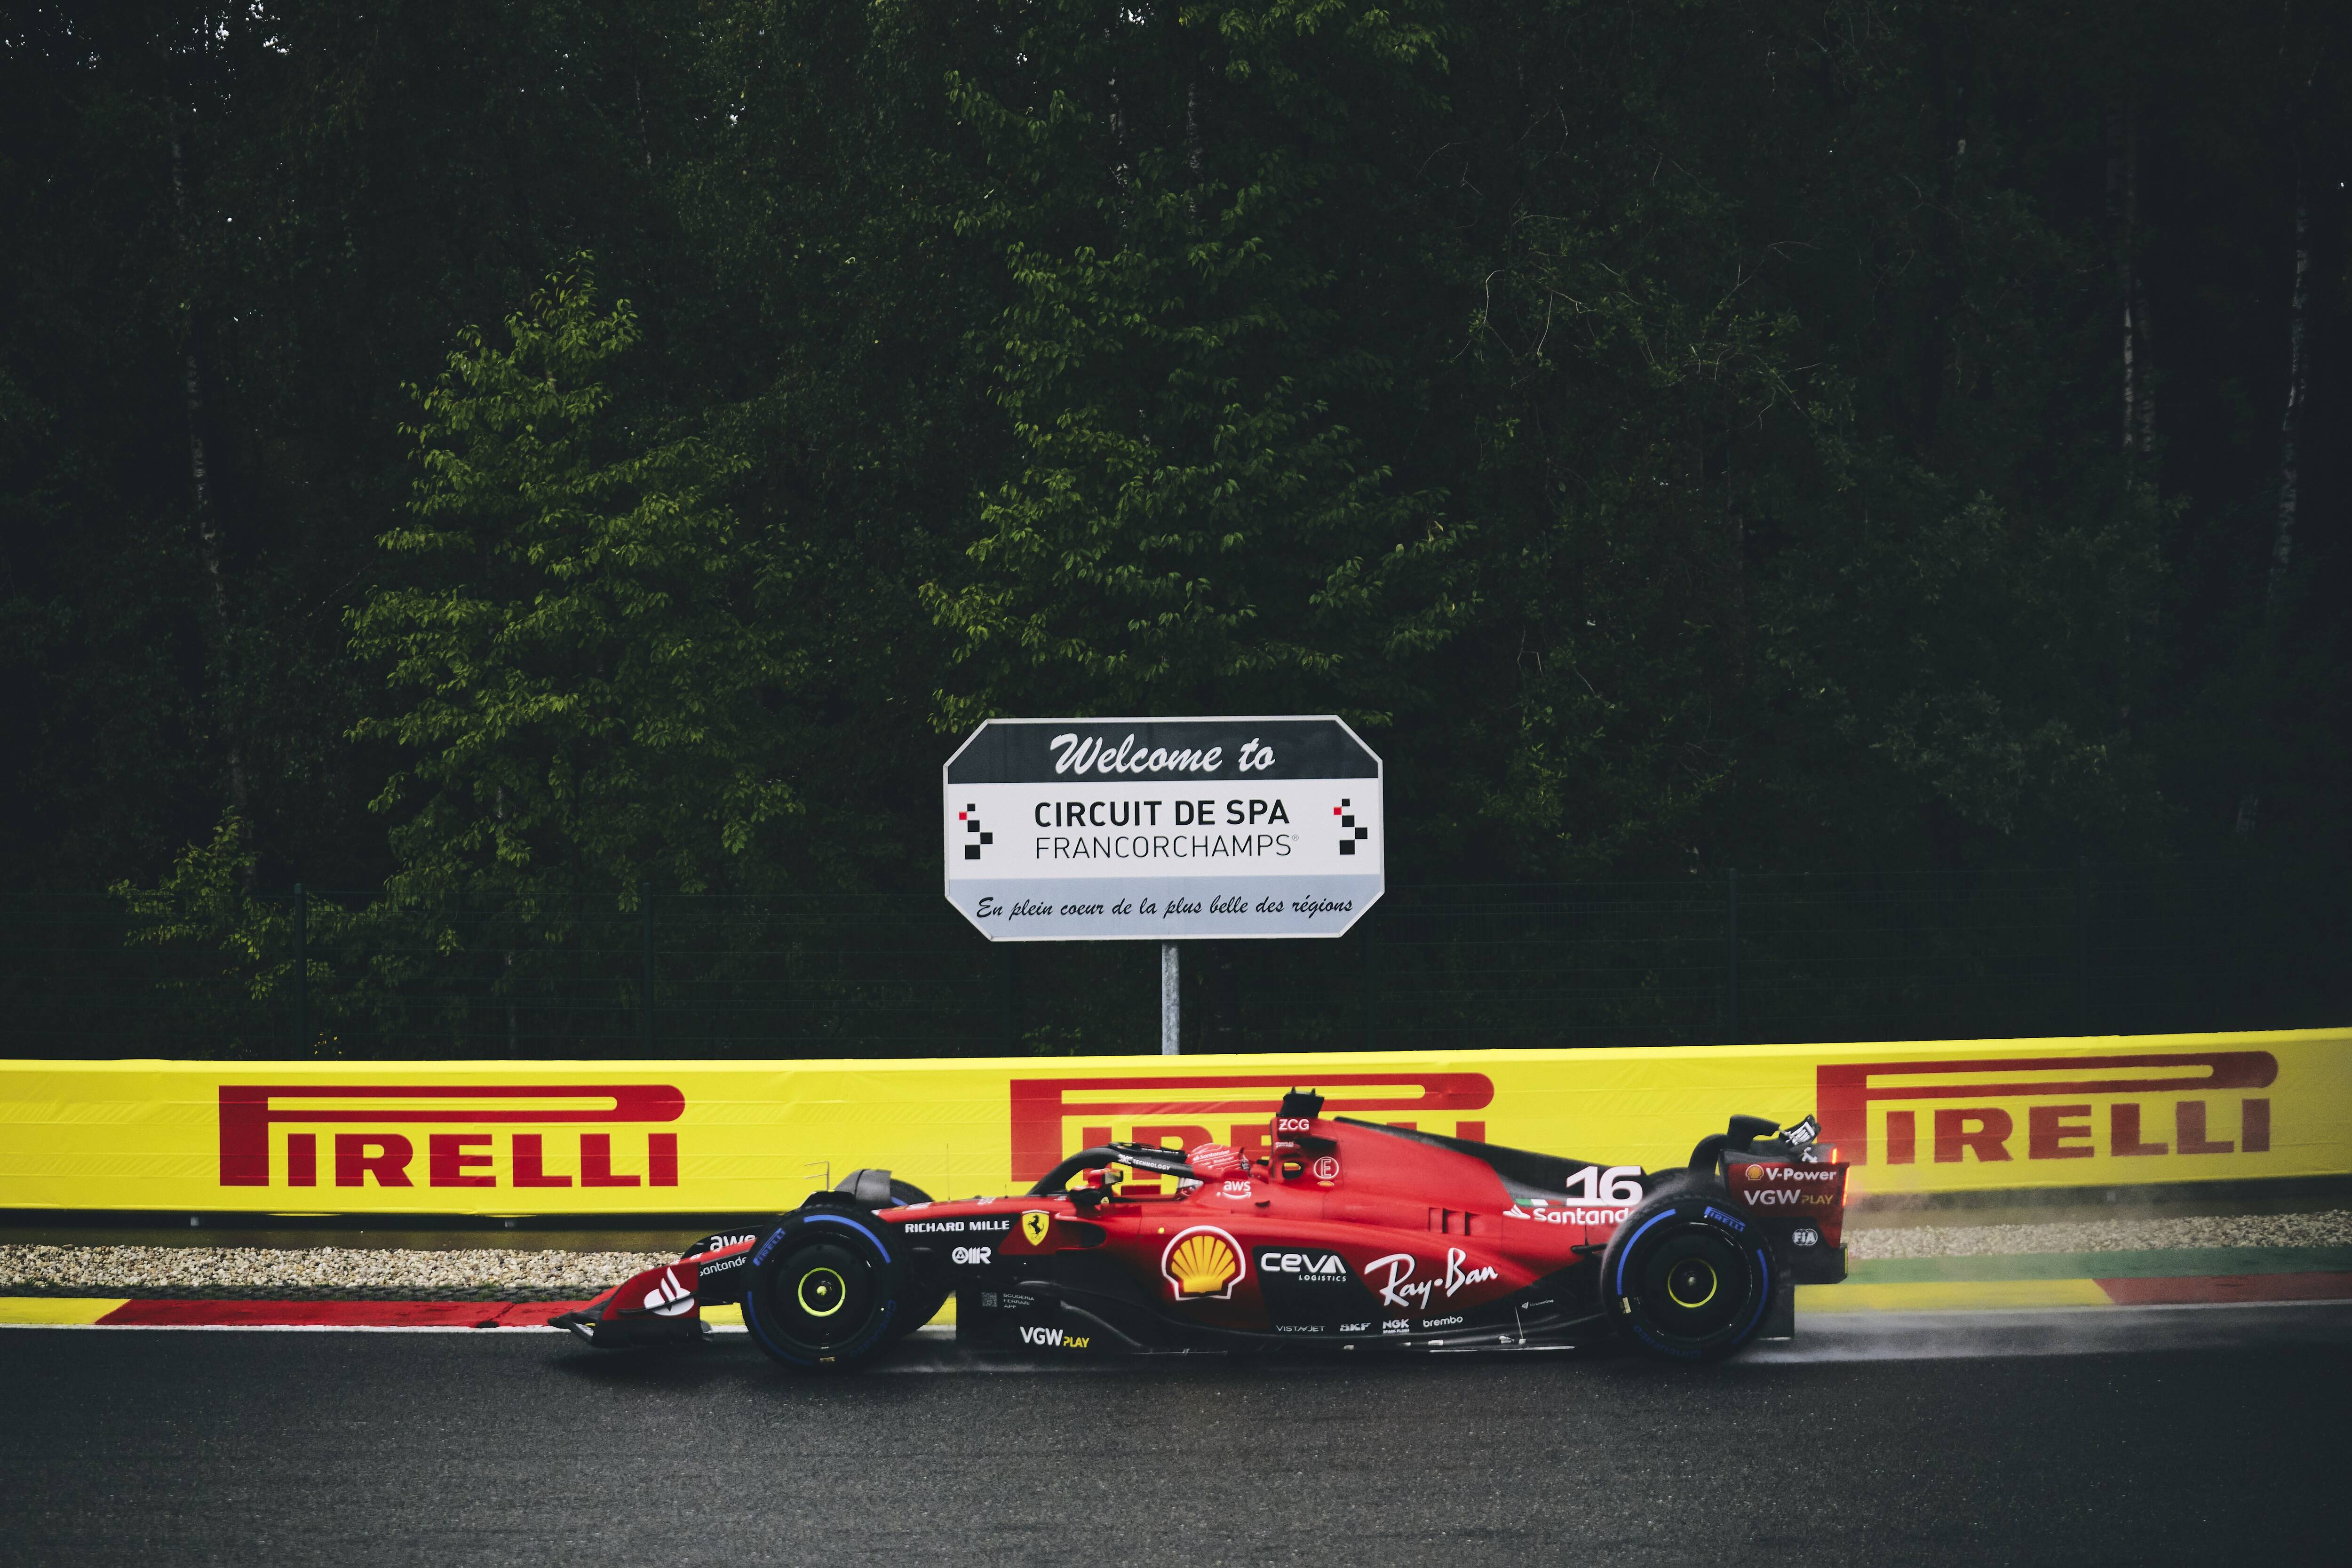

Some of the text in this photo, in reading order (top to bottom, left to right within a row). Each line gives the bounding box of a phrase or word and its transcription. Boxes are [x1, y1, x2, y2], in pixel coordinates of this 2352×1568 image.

[1049, 733, 1275, 775] Welcome to
[1035, 799, 1290, 827] CIRCUIT DE SPA
[976, 894, 1353, 921] En plein coeur de la plus belle des régions
[1816, 1051, 2279, 1166] PIRELLI
[1279, 1119, 1309, 1130] ZCG
[219, 1085, 685, 1187] PIRELLI
[1133, 1159, 1171, 1170] TECHNOLOGY
[1766, 1167, 1836, 1180] V-Power
[1223, 1181, 1251, 1192] aws
[1566, 1165, 1643, 1207] 16
[1533, 1208, 1629, 1226] Santand
[1704, 1206, 1746, 1232] PIRELLI
[905, 1220, 1010, 1233] RICHARD MILLE
[700, 1256, 747, 1277] antand
[1339, 1322, 1371, 1331] SKF
[1383, 1319, 1409, 1329] NGK
[1422, 1316, 1463, 1328] brembo
